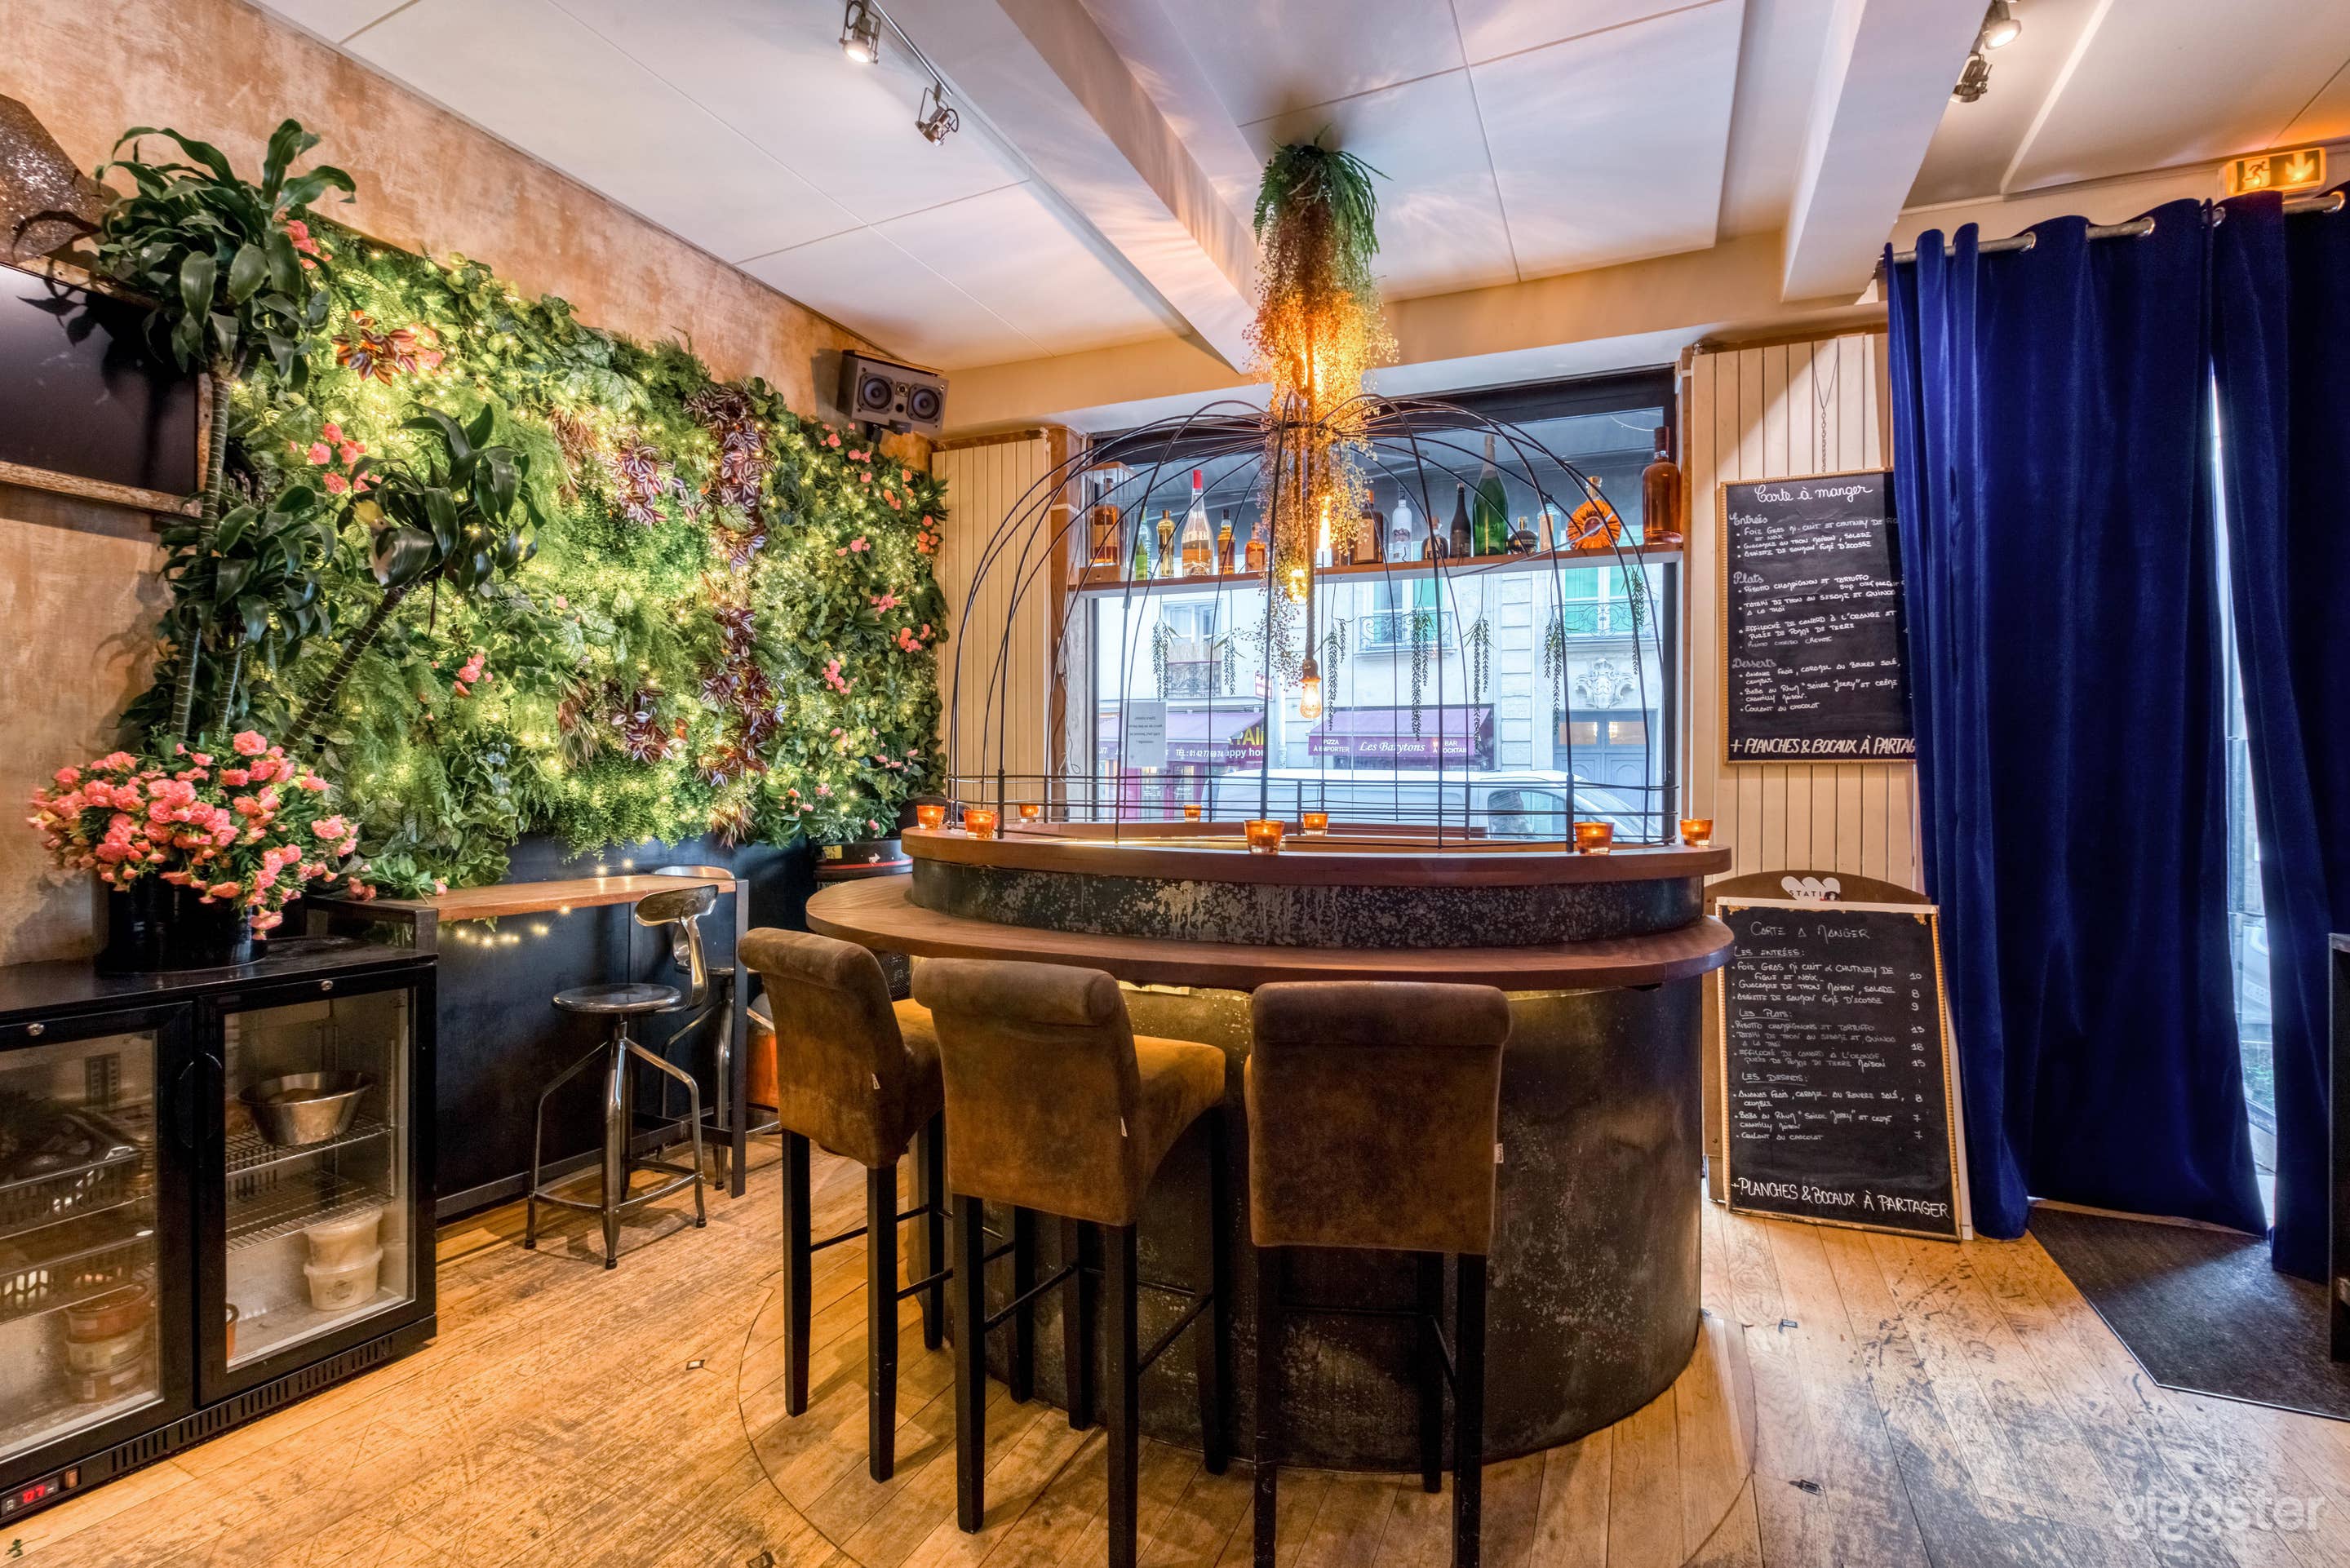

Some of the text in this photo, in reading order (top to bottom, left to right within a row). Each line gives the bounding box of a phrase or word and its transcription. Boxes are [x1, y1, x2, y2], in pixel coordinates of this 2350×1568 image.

[1754, 485, 1873, 503] Carte à manger
[1733, 571, 1763, 584] Plats
[1731, 658, 1776, 670] Desserts
[1359, 742, 1377, 751] Les
[1744, 737, 1799, 754] PLANCHES
[1811, 737, 1857, 754] BOCAUX
[1873, 737, 1916, 755] PARTAG
[1226, 749, 1247, 760] appy
[1750, 922, 1786, 937] CARTE
[1912, 990, 1919, 998] 8
[1912, 1003, 1919, 1011] 9
[1910, 1043, 1925, 1051] 18
[1911, 1059, 1926, 1067] 15
[1915, 1094, 1922, 1102] 8
[1738, 1177, 1798, 1200] PLANCHES
[1811, 1186, 1859, 1207] BOCAUX
[1877, 1194, 1951, 1220] PARTAGER
